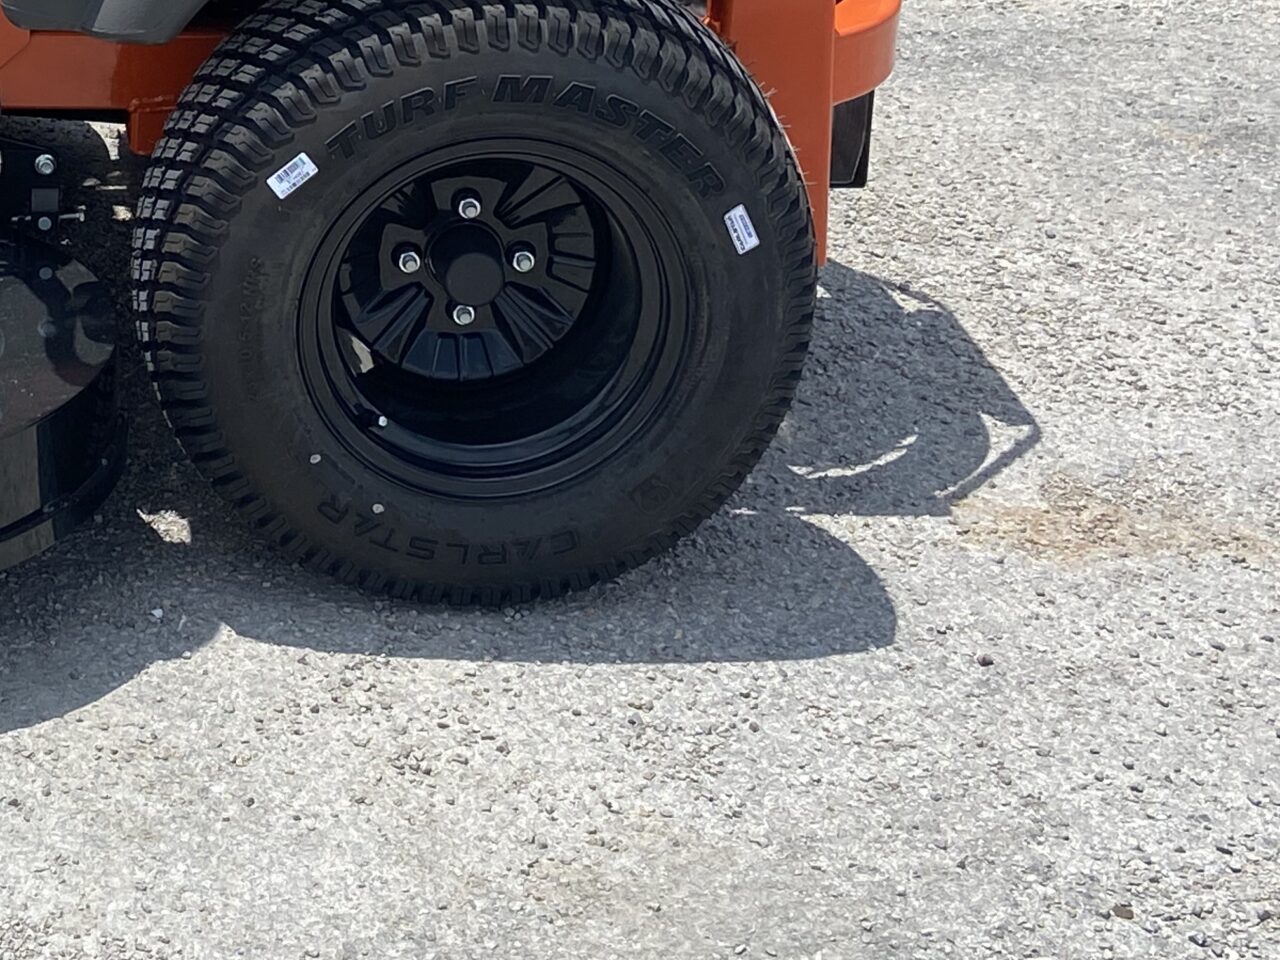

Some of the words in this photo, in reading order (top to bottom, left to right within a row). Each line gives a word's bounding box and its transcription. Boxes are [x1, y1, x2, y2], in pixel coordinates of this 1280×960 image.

[324, 75, 477, 159] TURF
[492, 74, 726, 199] MASTER
[317, 493, 579, 566] CARLSTAR
